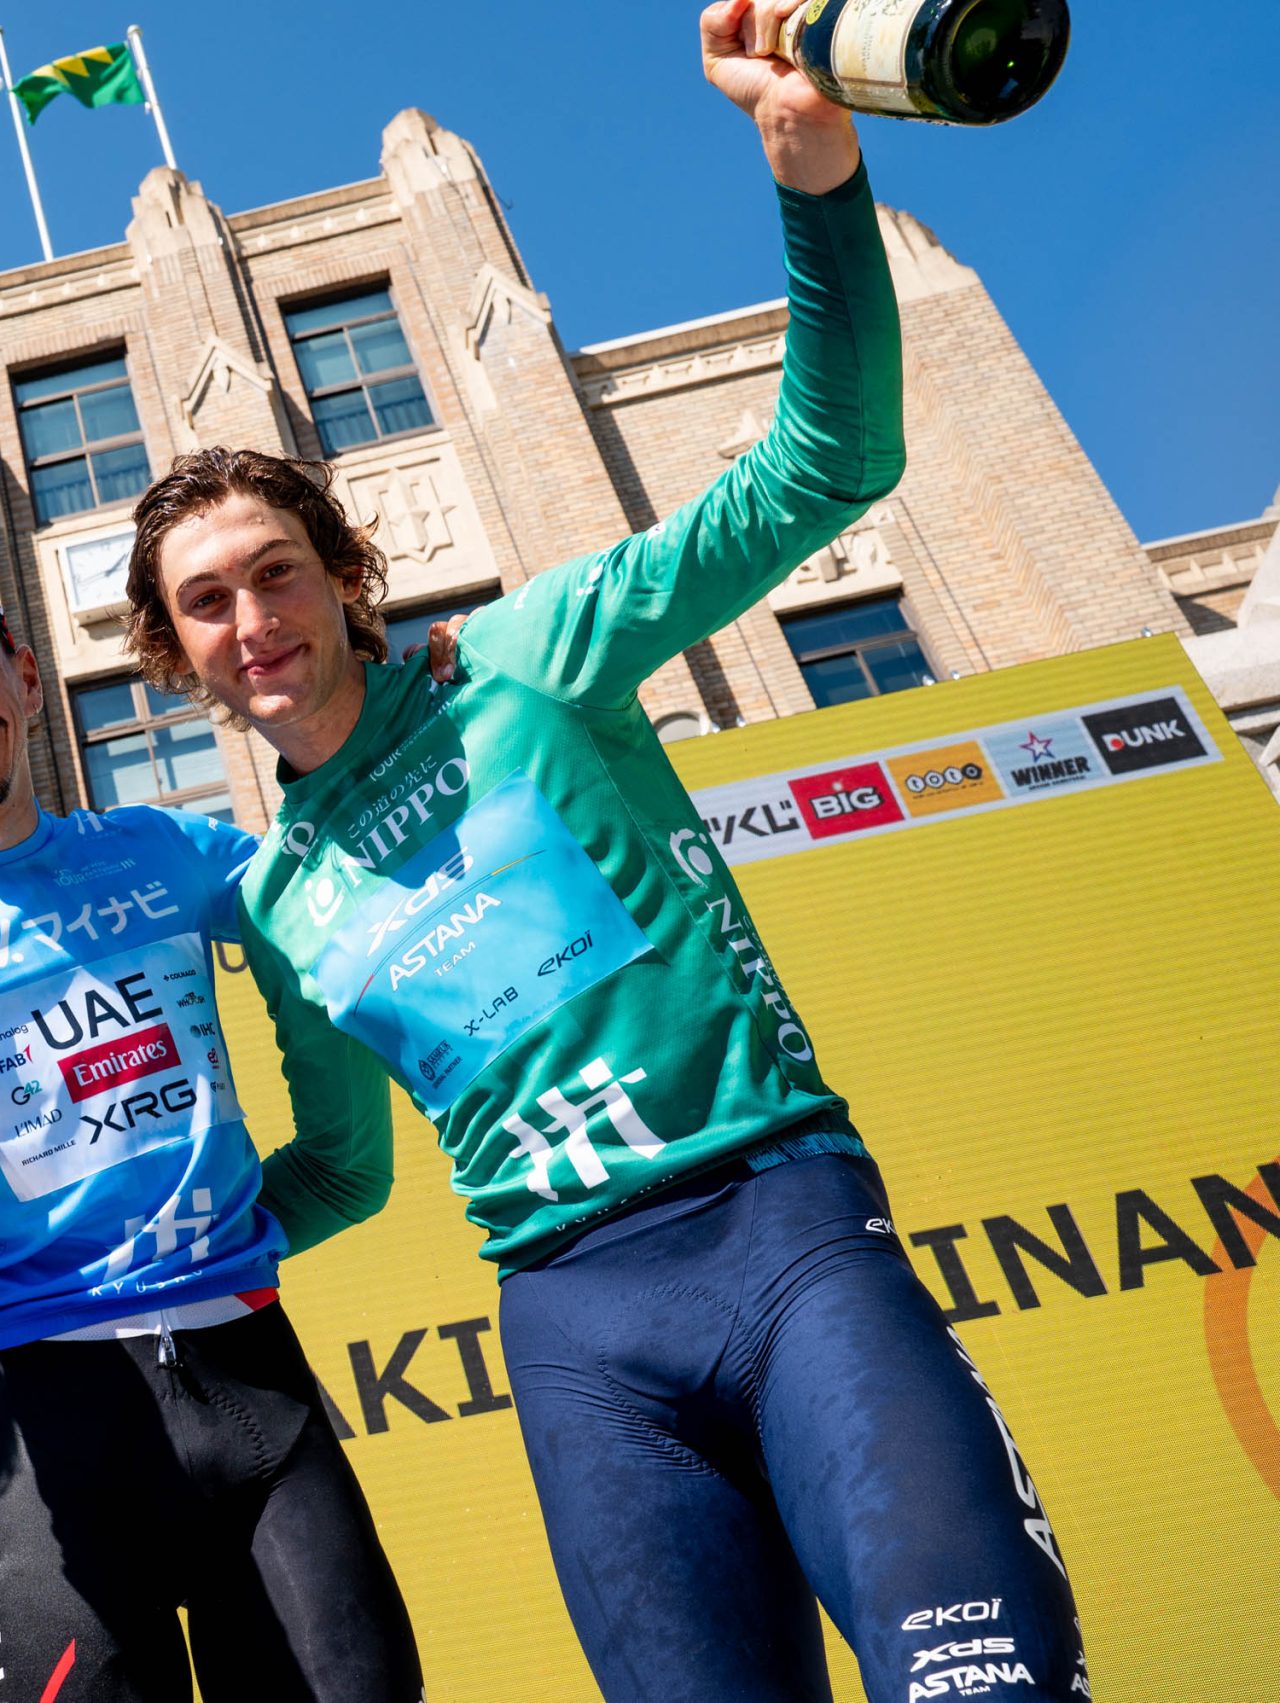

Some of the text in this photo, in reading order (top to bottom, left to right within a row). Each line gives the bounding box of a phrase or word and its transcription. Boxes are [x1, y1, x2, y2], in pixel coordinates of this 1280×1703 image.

[1101, 719, 1185, 752] DUNK
[905, 763, 983, 793] toto
[1011, 756, 1091, 788] WINNER
[346, 755, 438, 839] この道の先に
[810, 784, 882, 820] BIG
[341, 757, 471, 889] NIPPO
[21, 880, 180, 952] マイナビ
[389, 893, 501, 991] ASTANA
[433, 941, 476, 977] TEAM
[170, 969, 197, 980] COLNAGO
[705, 894, 814, 1061] NIPPO
[31, 972, 163, 1051] UAE
[200, 1022, 216, 1038] IHC
[464, 986, 519, 1036] X-LAB
[73, 1039, 168, 1087] Emirates
[11, 1080, 43, 1105] G42
[80, 1078, 197, 1145] XRG
[22, 1139, 76, 1166] RICHARD MILLE
[909, 1662, 1035, 1703] ASTANA
[959, 1685, 991, 1697] TEAM
